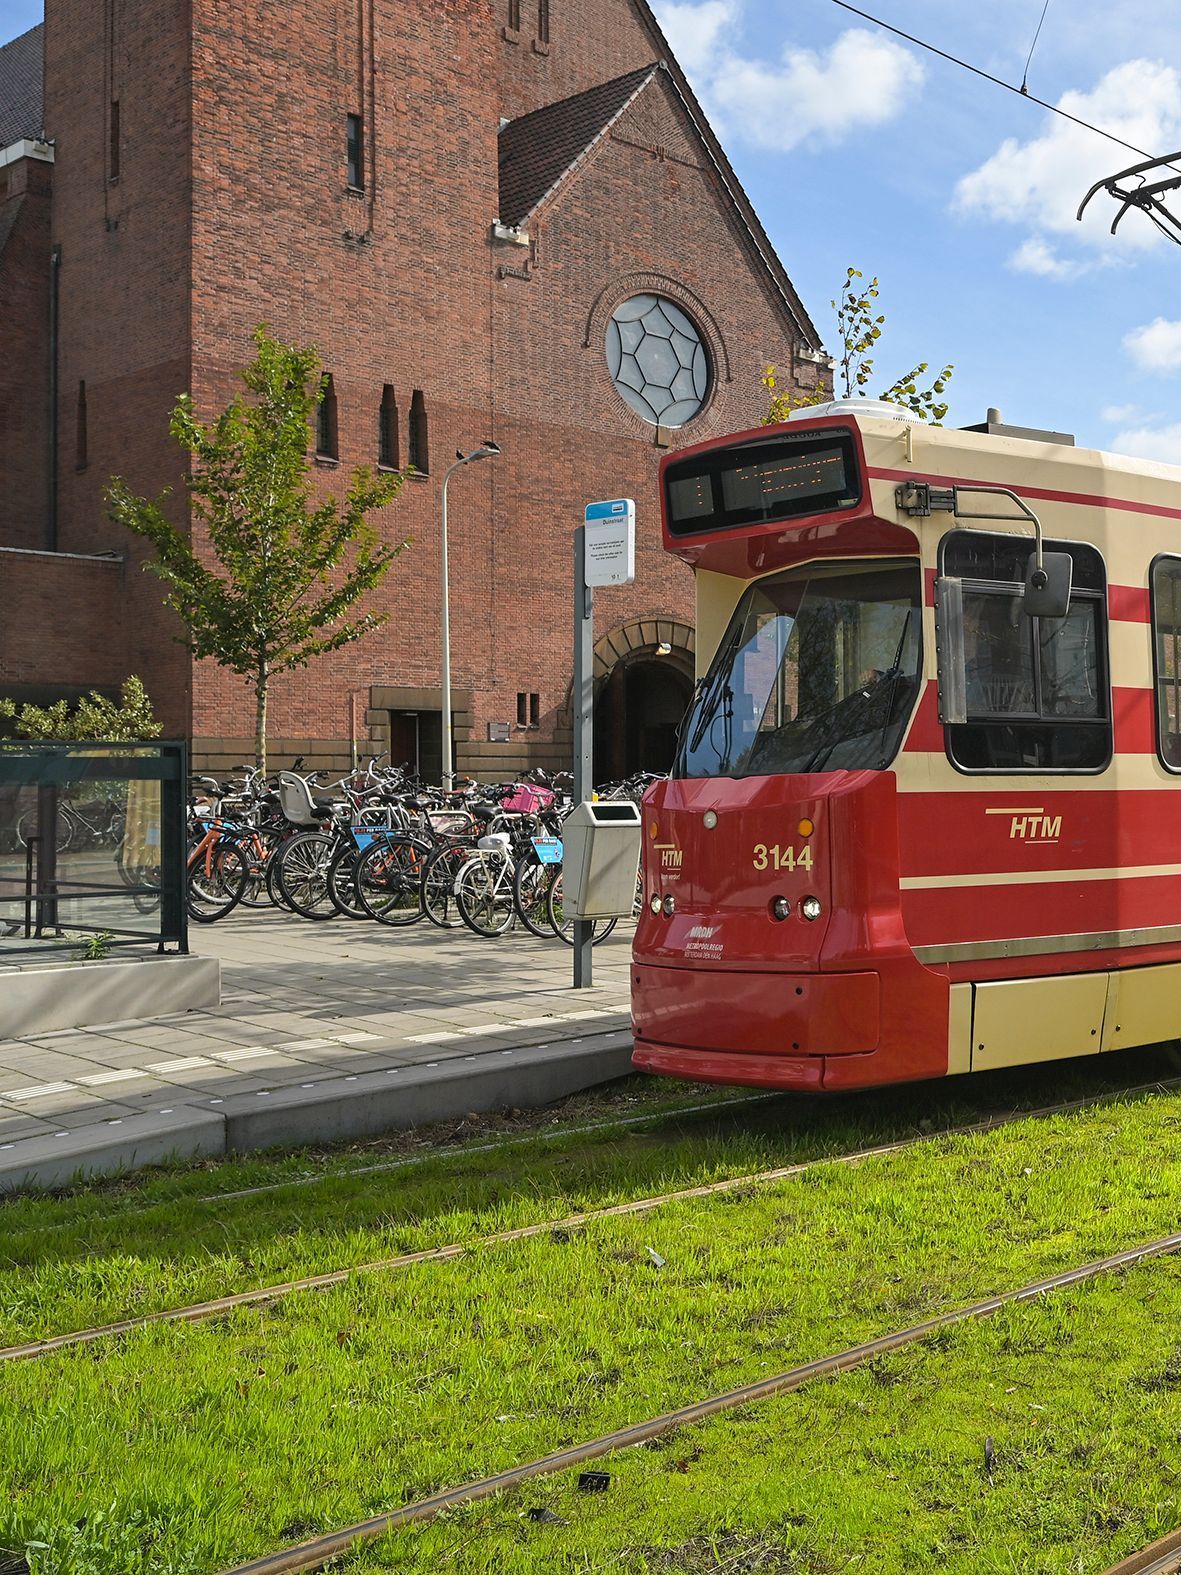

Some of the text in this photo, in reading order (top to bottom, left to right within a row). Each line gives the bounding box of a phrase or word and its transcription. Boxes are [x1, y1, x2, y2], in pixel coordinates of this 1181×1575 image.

[1009, 816, 1062, 838] HTM
[661, 850, 683, 866] HTM
[753, 843, 813, 872] 3144
